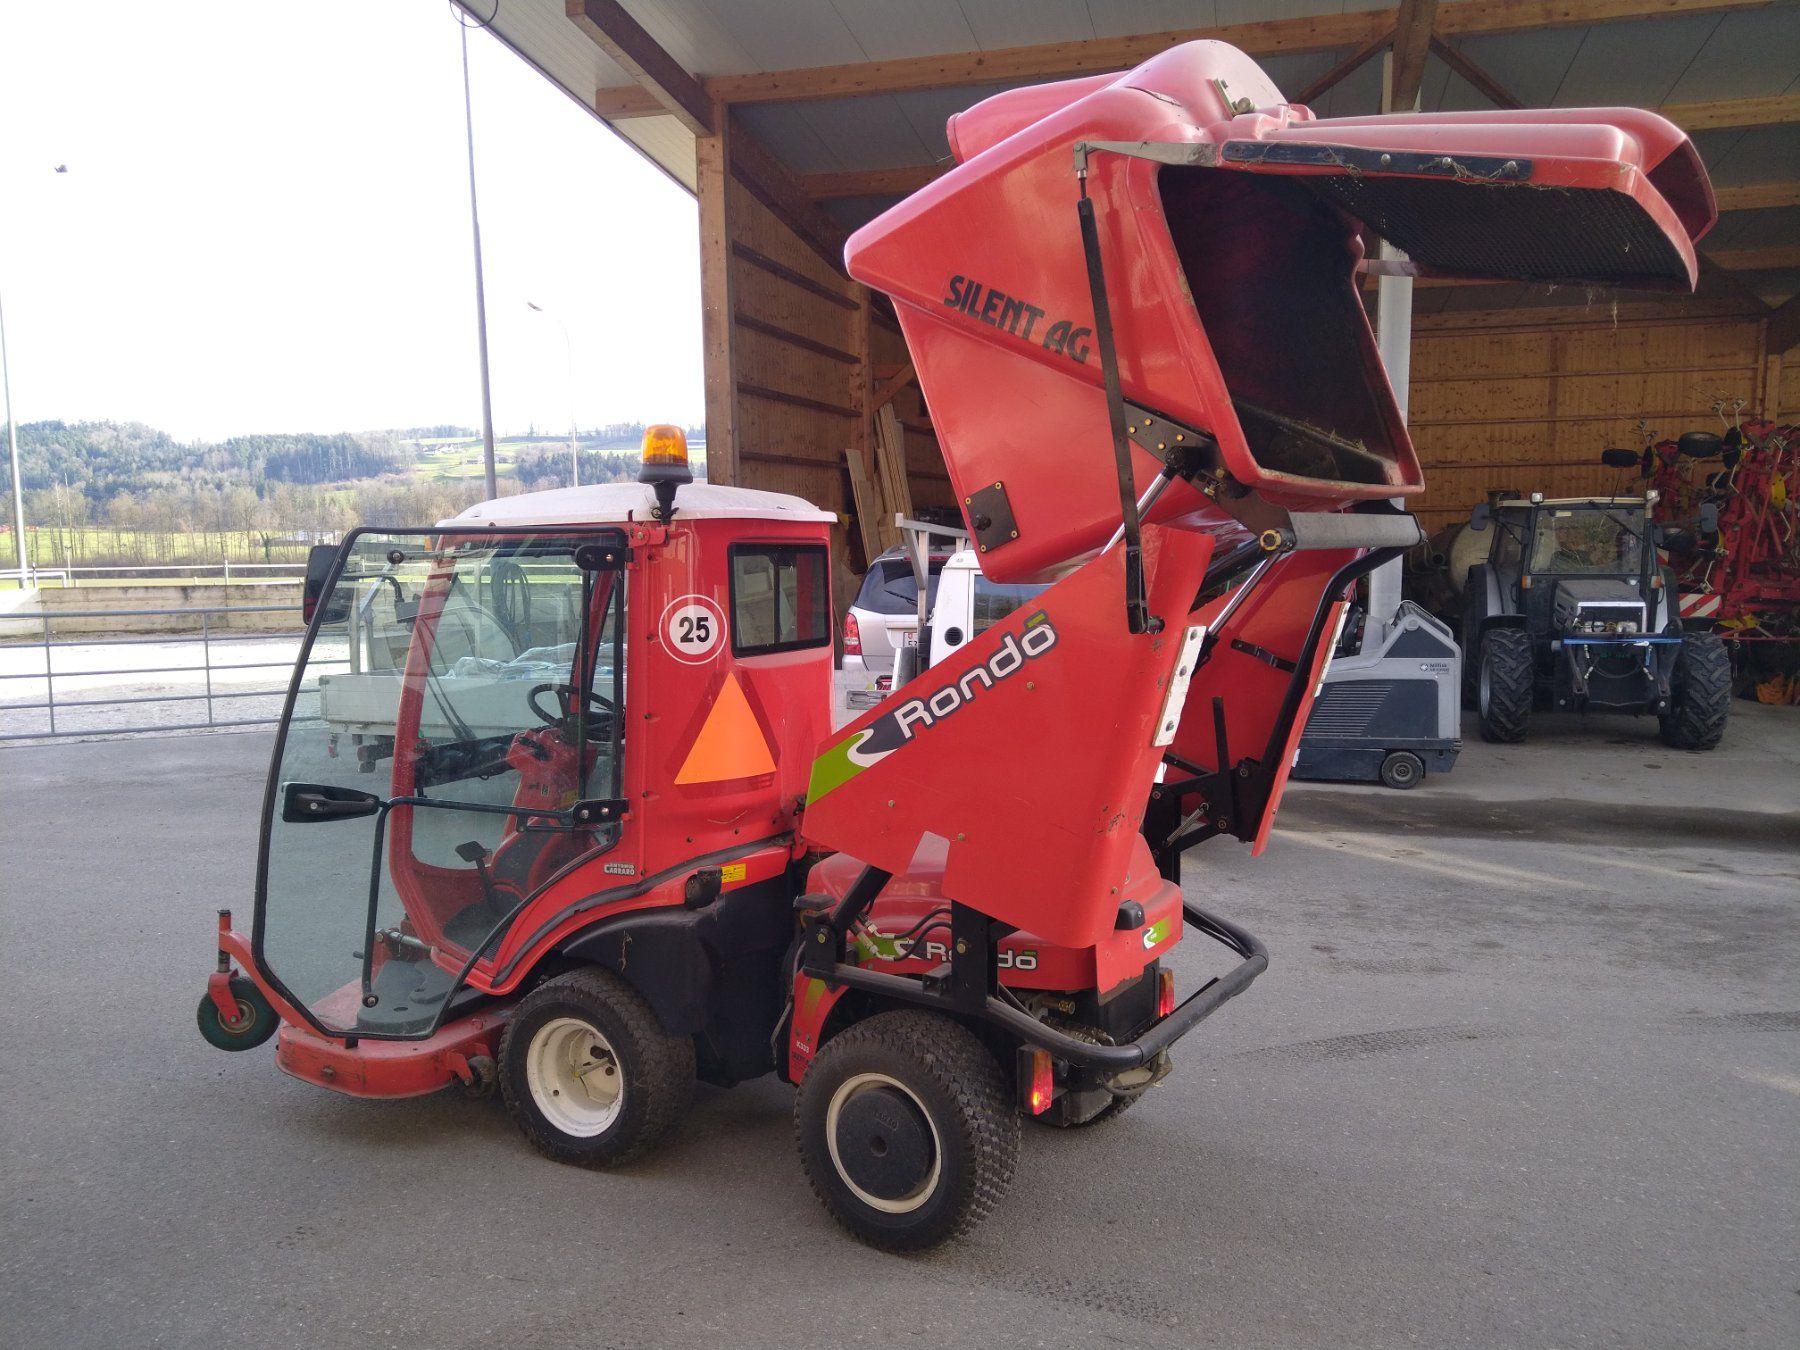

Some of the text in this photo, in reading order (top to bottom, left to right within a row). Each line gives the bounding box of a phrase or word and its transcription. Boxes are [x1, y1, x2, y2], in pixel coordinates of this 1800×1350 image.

[944, 274, 1092, 364] SILENT AG
[678, 616, 710, 643] 25
[604, 864, 635, 876] CARRARO
